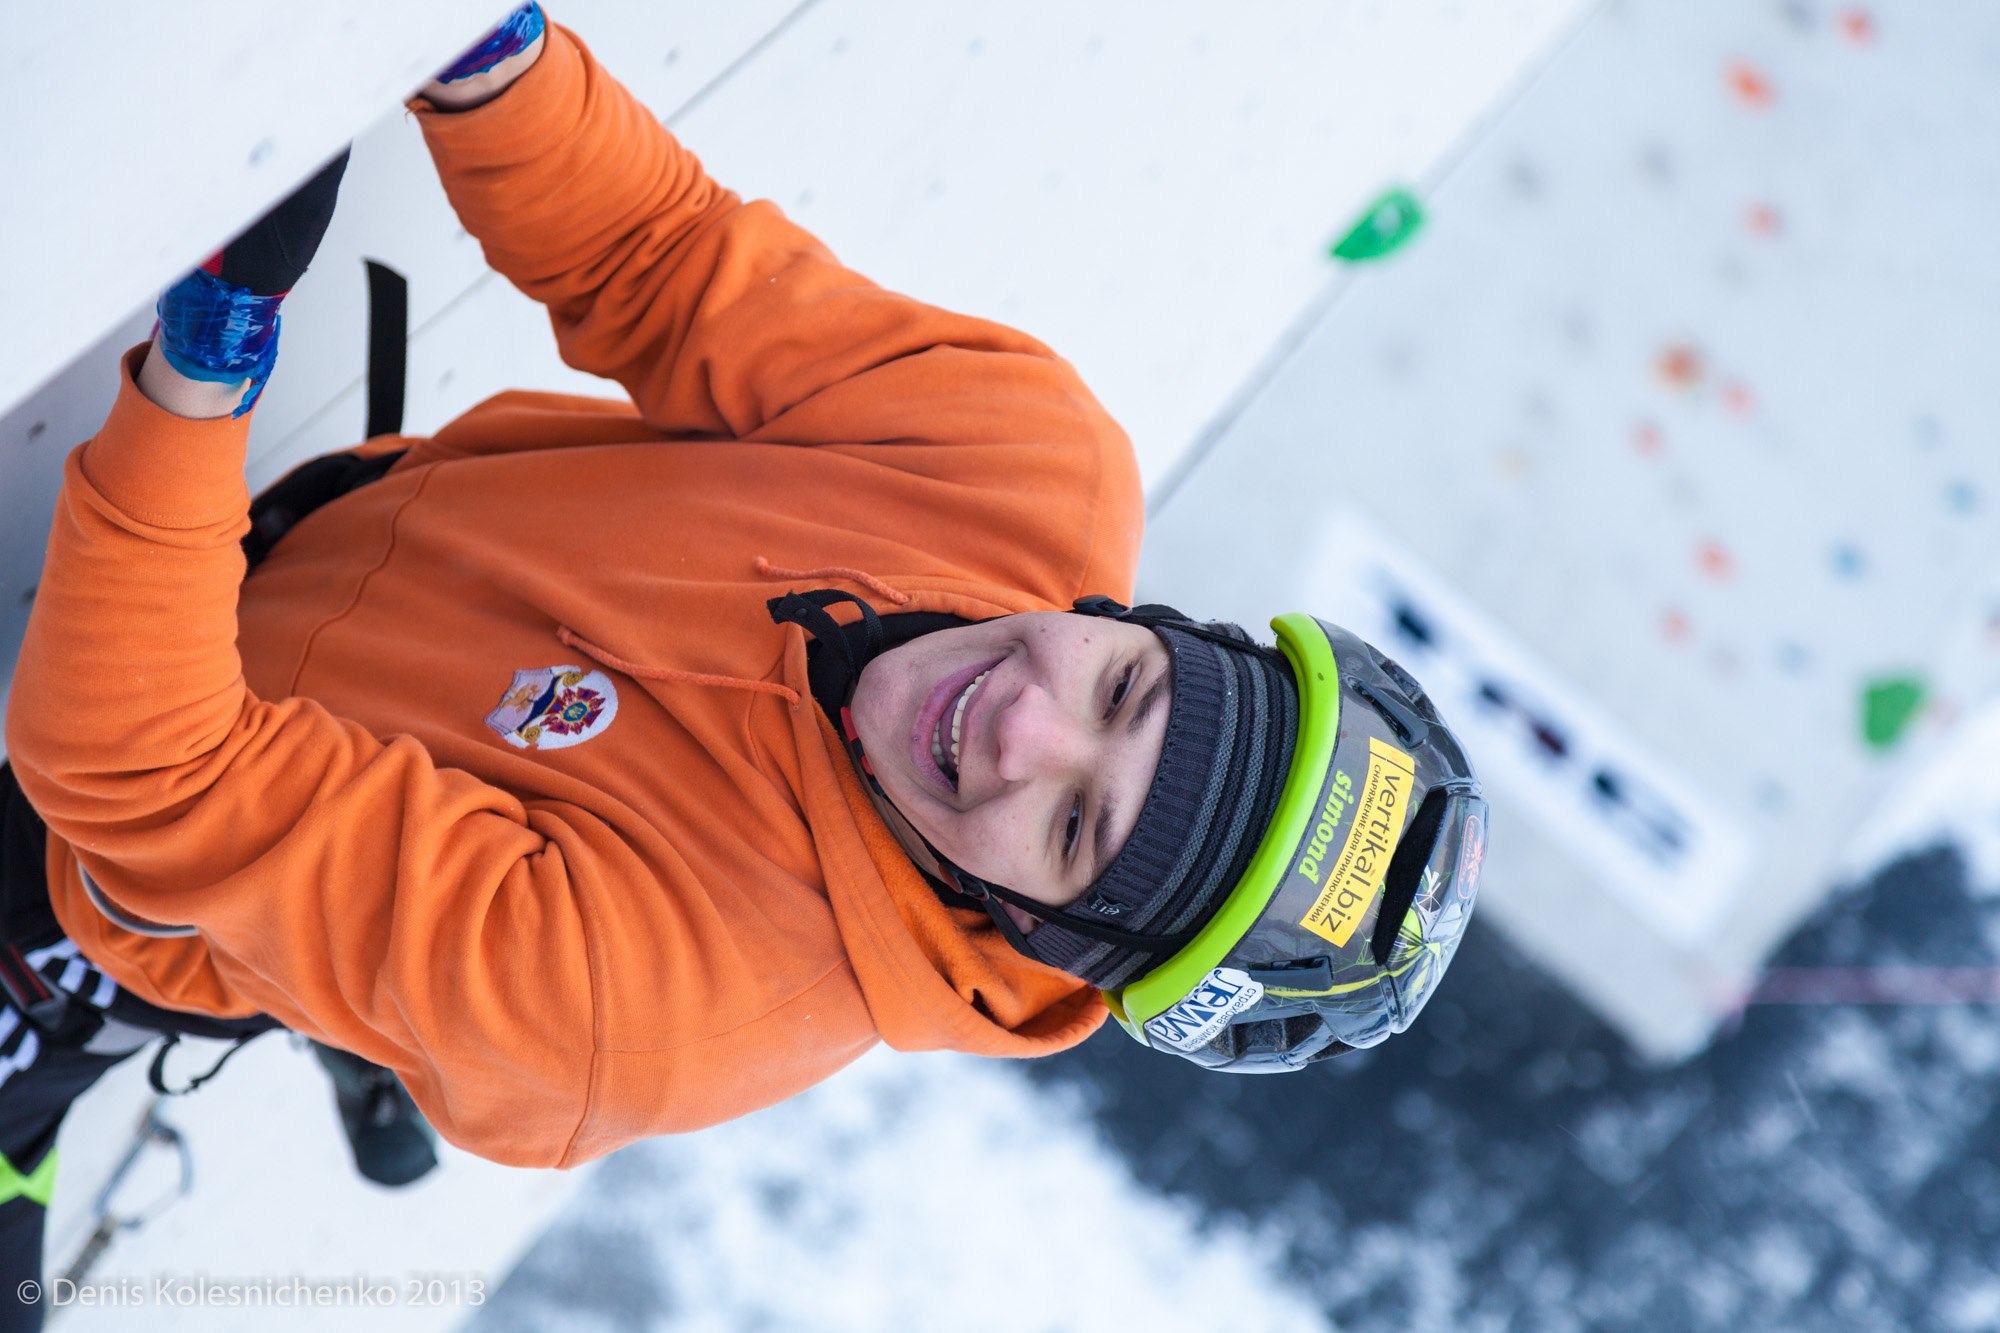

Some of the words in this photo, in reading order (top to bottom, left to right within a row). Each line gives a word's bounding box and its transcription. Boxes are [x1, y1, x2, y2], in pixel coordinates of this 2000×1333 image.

[1299, 769, 1355, 885] simond
[1356, 764, 1382, 832] СНАРЯЖЕНИЕ
[1320, 775, 1400, 932] vertikal.biz
[1347, 829, 1364, 850] ДЛЯ
[1309, 849, 1354, 922] ПРИКЛЮЧЕНИЙ
